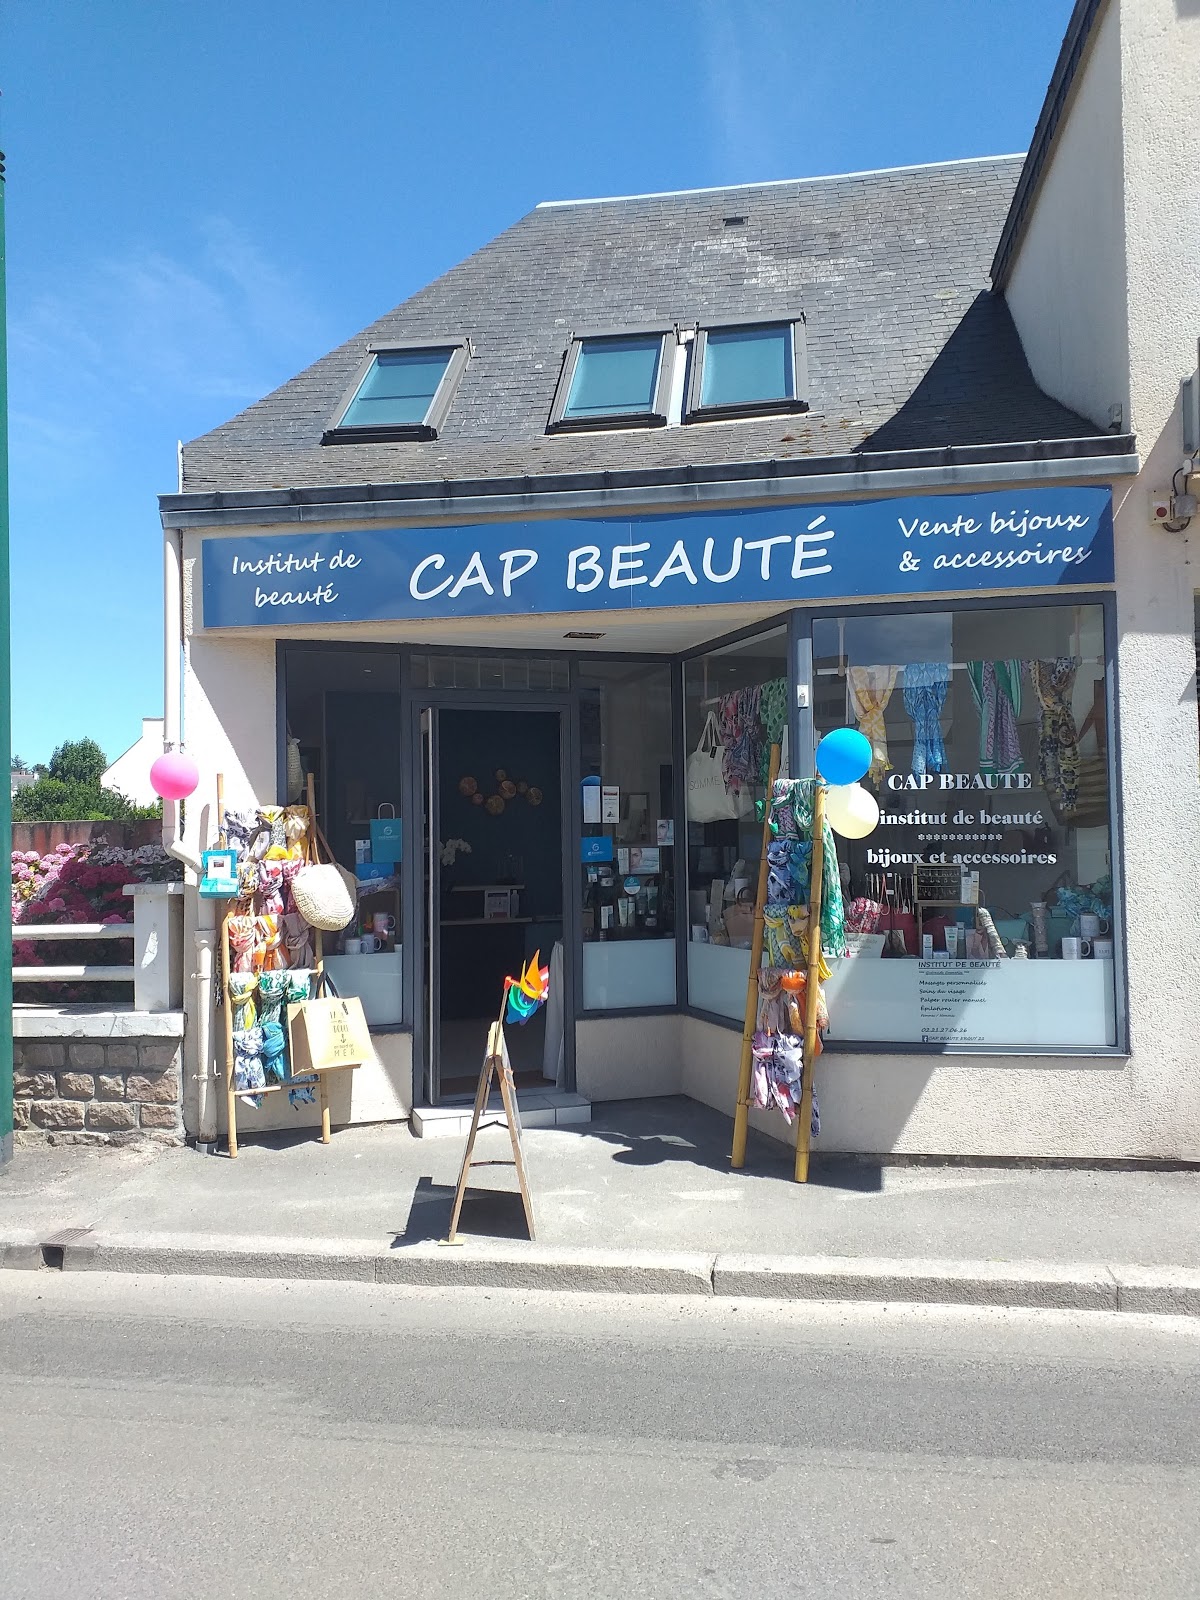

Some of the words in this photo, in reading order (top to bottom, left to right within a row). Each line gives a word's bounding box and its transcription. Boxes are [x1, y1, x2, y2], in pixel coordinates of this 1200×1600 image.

[898, 513, 982, 538] Vente
[989, 508, 1090, 541] bijoux
[231, 553, 326, 575] Institut
[328, 549, 363, 571] de
[408, 548, 539, 601] CAP
[565, 515, 836, 594] BEAUTÉ
[898, 550, 921, 572] &
[933, 541, 1093, 571] accessoires
[253, 583, 340, 609] beauté
[887, 773, 934, 791] CAP
[938, 773, 1033, 790] BEAUTE
[879, 809, 947, 825] institut
[952, 809, 975, 825] de
[979, 809, 1044, 825] beauté
[866, 848, 924, 868] bijoux
[929, 851, 948, 865] et
[952, 848, 1057, 865] accessoires
[969, 960, 1001, 968] BEAUTÉ
[947, 988, 966, 996] visage
